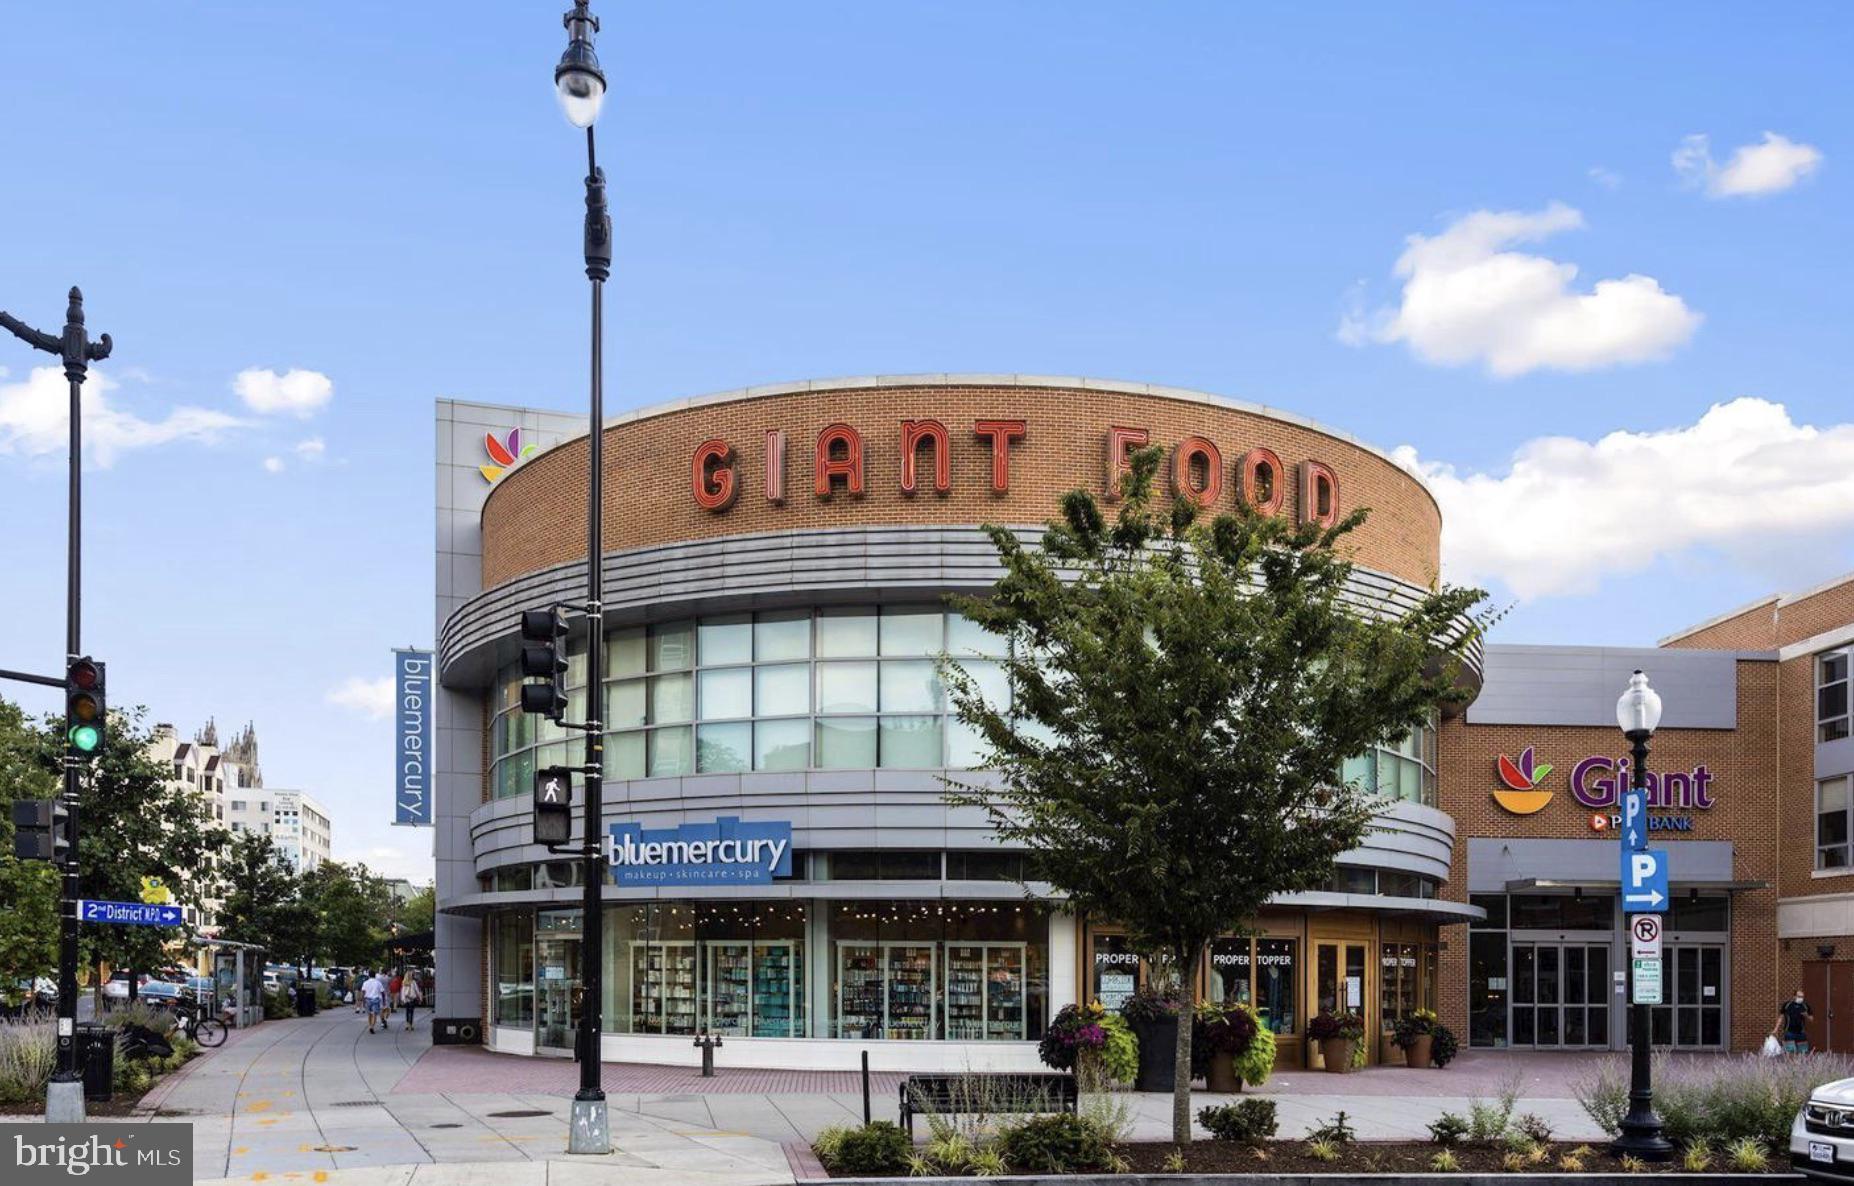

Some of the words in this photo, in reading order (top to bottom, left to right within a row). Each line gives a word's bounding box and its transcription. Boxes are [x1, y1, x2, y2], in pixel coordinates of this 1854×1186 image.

[692, 419, 1026, 508] GIANT
[1108, 426, 1340, 530] FOOD
[398, 658, 430, 817] bluemercury
[1626, 794, 1640, 828] P
[1650, 816, 1692, 831] BANK
[608, 833, 787, 872] bluemercury
[624, 869, 667, 881] makeup
[675, 868, 728, 879] skincare
[738, 869, 760, 880] spa
[1632, 854, 1657, 887] P
[107, 904, 143, 921] District
[1095, 953, 1139, 964] PROPER
[1213, 954, 1250, 965] PROPER
[1256, 955, 1292, 965] TOPPER
